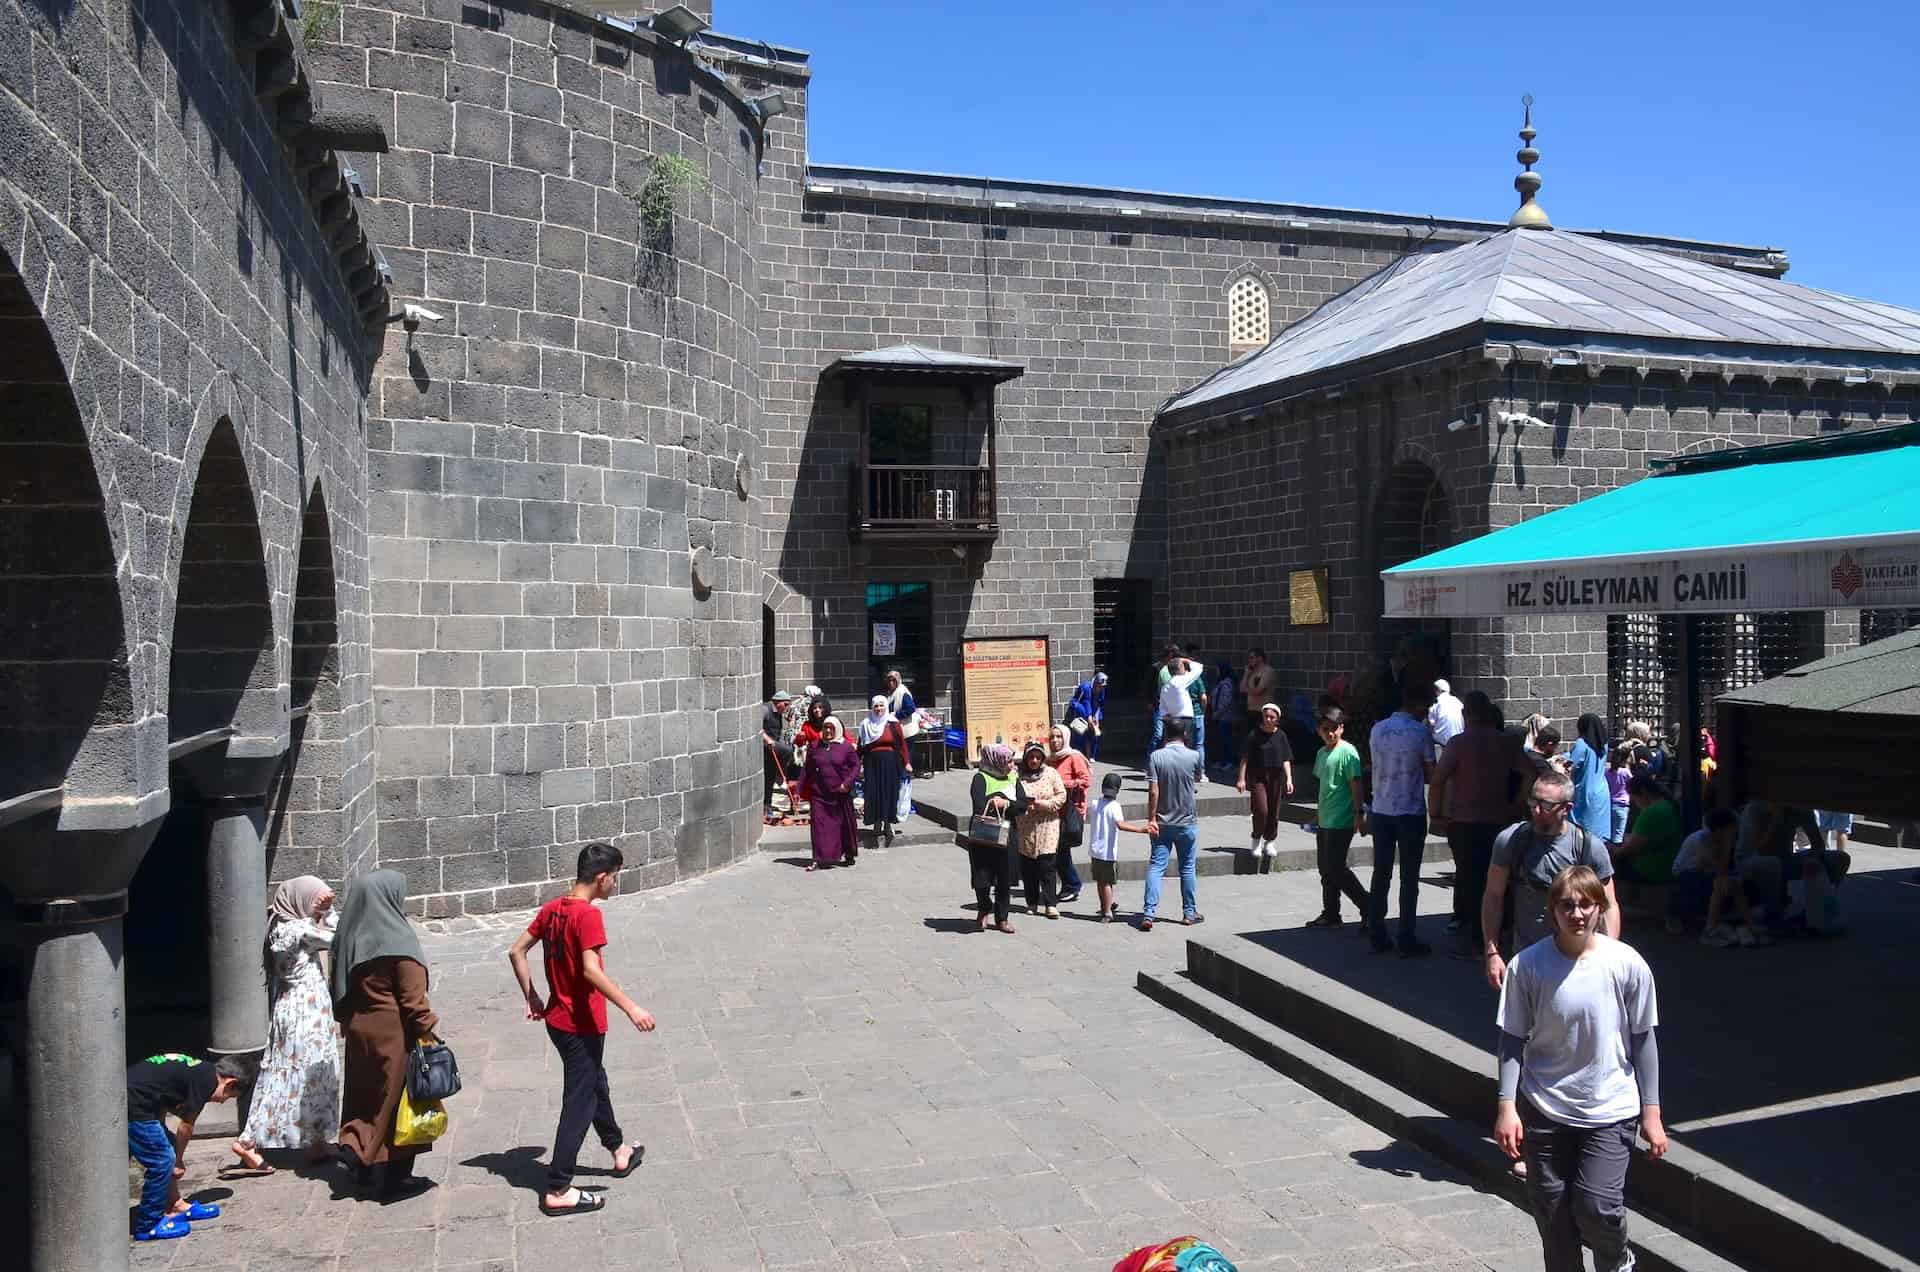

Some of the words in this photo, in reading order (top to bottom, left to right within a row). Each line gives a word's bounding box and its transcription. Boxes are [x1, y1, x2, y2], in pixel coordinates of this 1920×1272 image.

[1864, 564, 1918, 579] VAKIFLAR
[1507, 582, 1537, 607] HZ.
[1543, 575, 1658, 606] SÜLEYMAN
